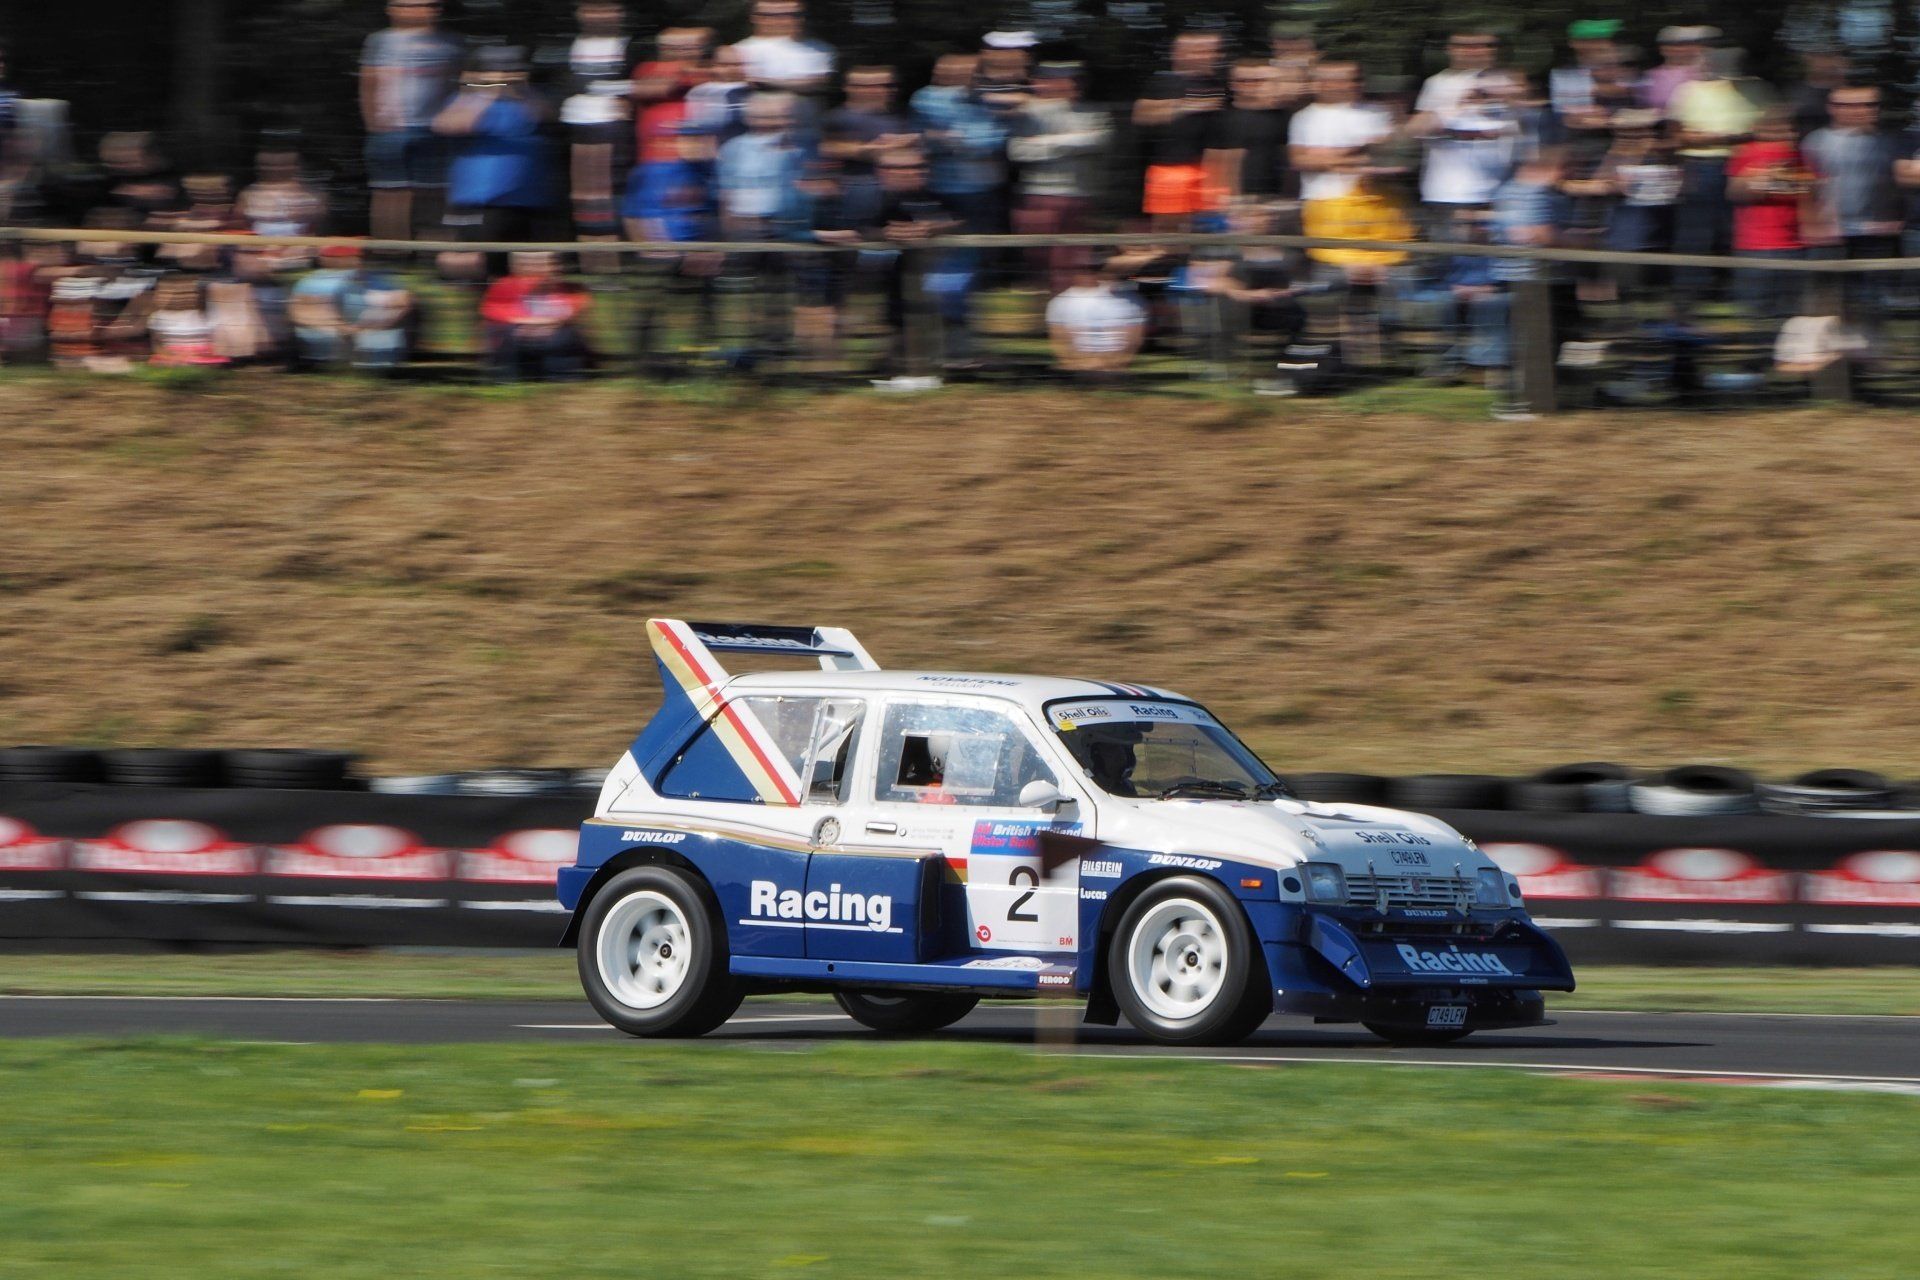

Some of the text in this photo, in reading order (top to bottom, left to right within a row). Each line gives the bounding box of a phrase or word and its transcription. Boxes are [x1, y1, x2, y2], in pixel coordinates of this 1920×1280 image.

[1058, 706, 1109, 721] Shell Oils
[1129, 705, 1179, 719] Racing
[993, 823, 1031, 836] British
[621, 830, 686, 844] DUNLOP
[1355, 831, 1431, 846] Shell Oils
[1081, 860, 1122, 873] BILSTEIN
[1148, 853, 1223, 870] DUNLOP
[1007, 865, 1040, 922] 2
[1080, 887, 1107, 900] Lucas
[750, 880, 892, 932] Racing
[1403, 909, 1448, 917] DUNLOP
[1396, 943, 1514, 976] Racing
[1038, 974, 1070, 985] FERODO
